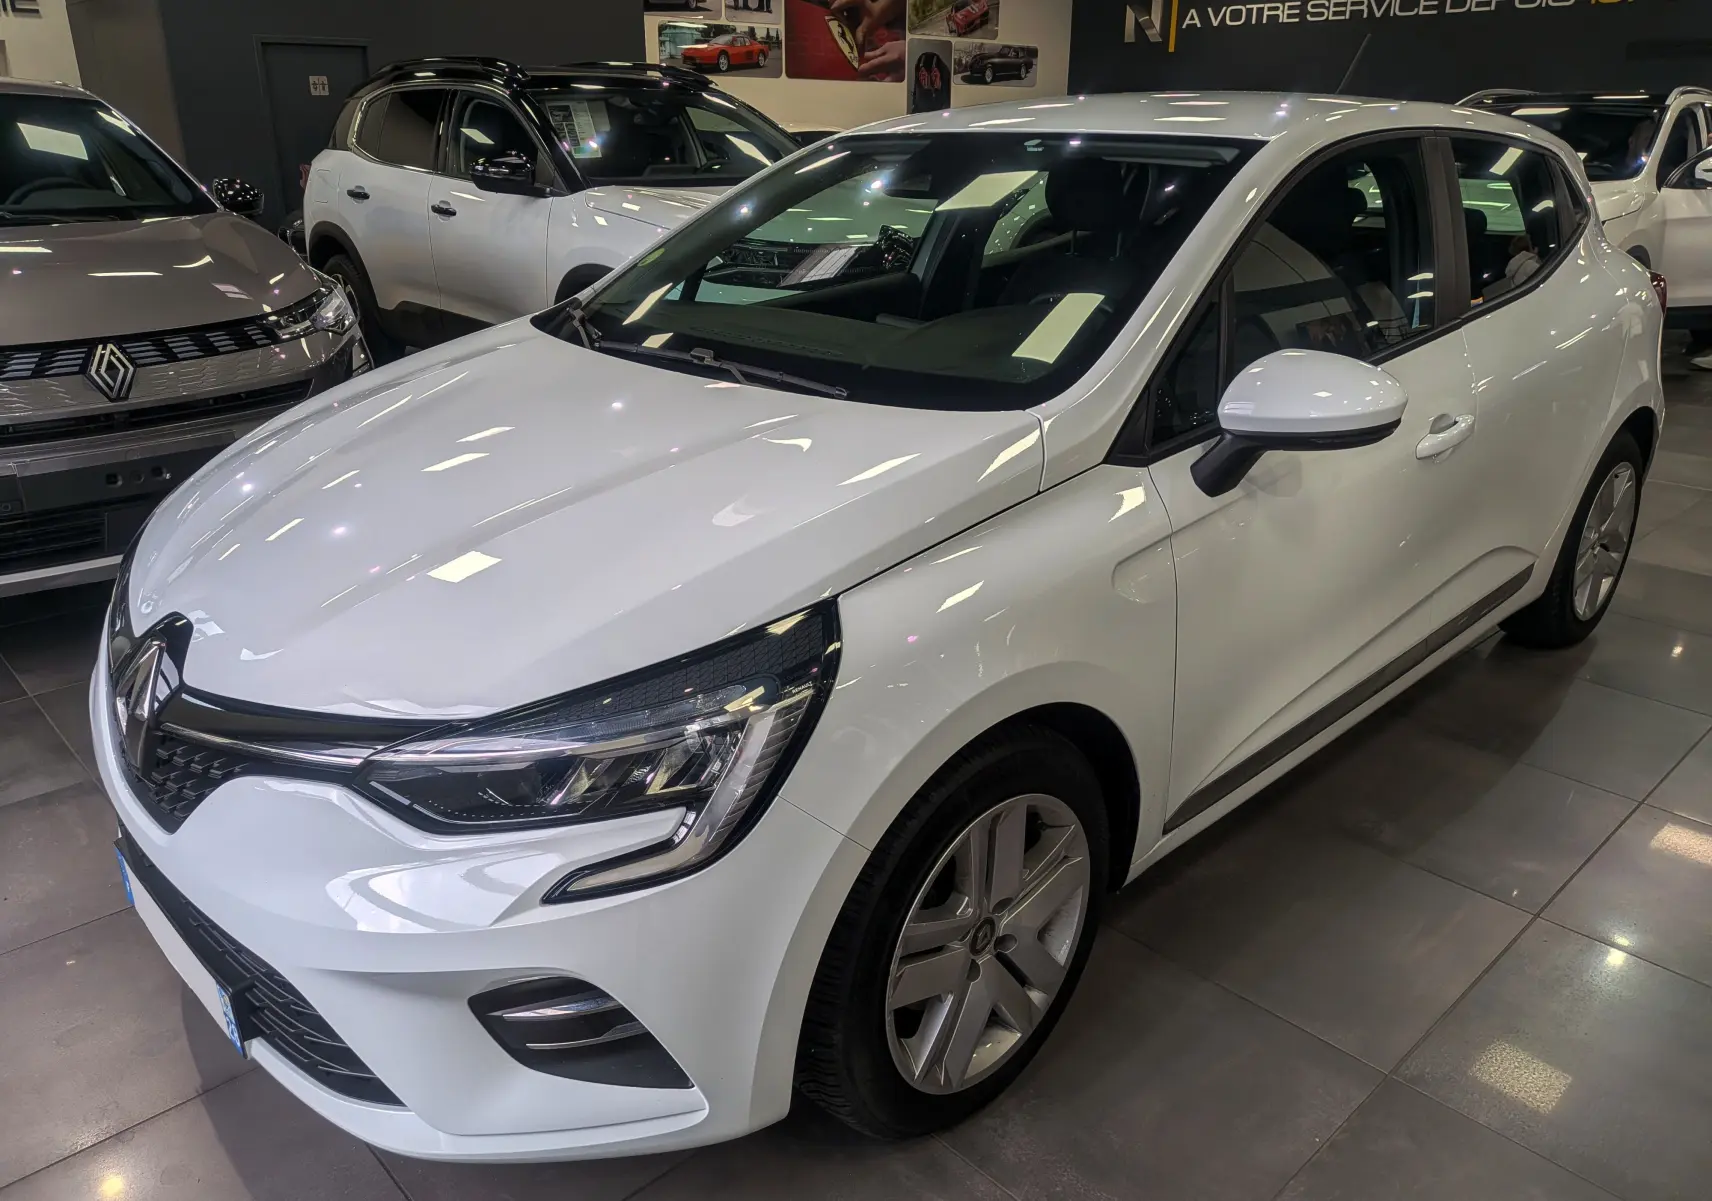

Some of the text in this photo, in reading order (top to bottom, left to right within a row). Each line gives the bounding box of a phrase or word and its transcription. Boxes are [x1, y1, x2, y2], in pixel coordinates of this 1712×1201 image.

[1181, 8, 1202, 29] A
[1207, 1, 1302, 27] VOTRE
[1306, 0, 1439, 21] SERVICE
